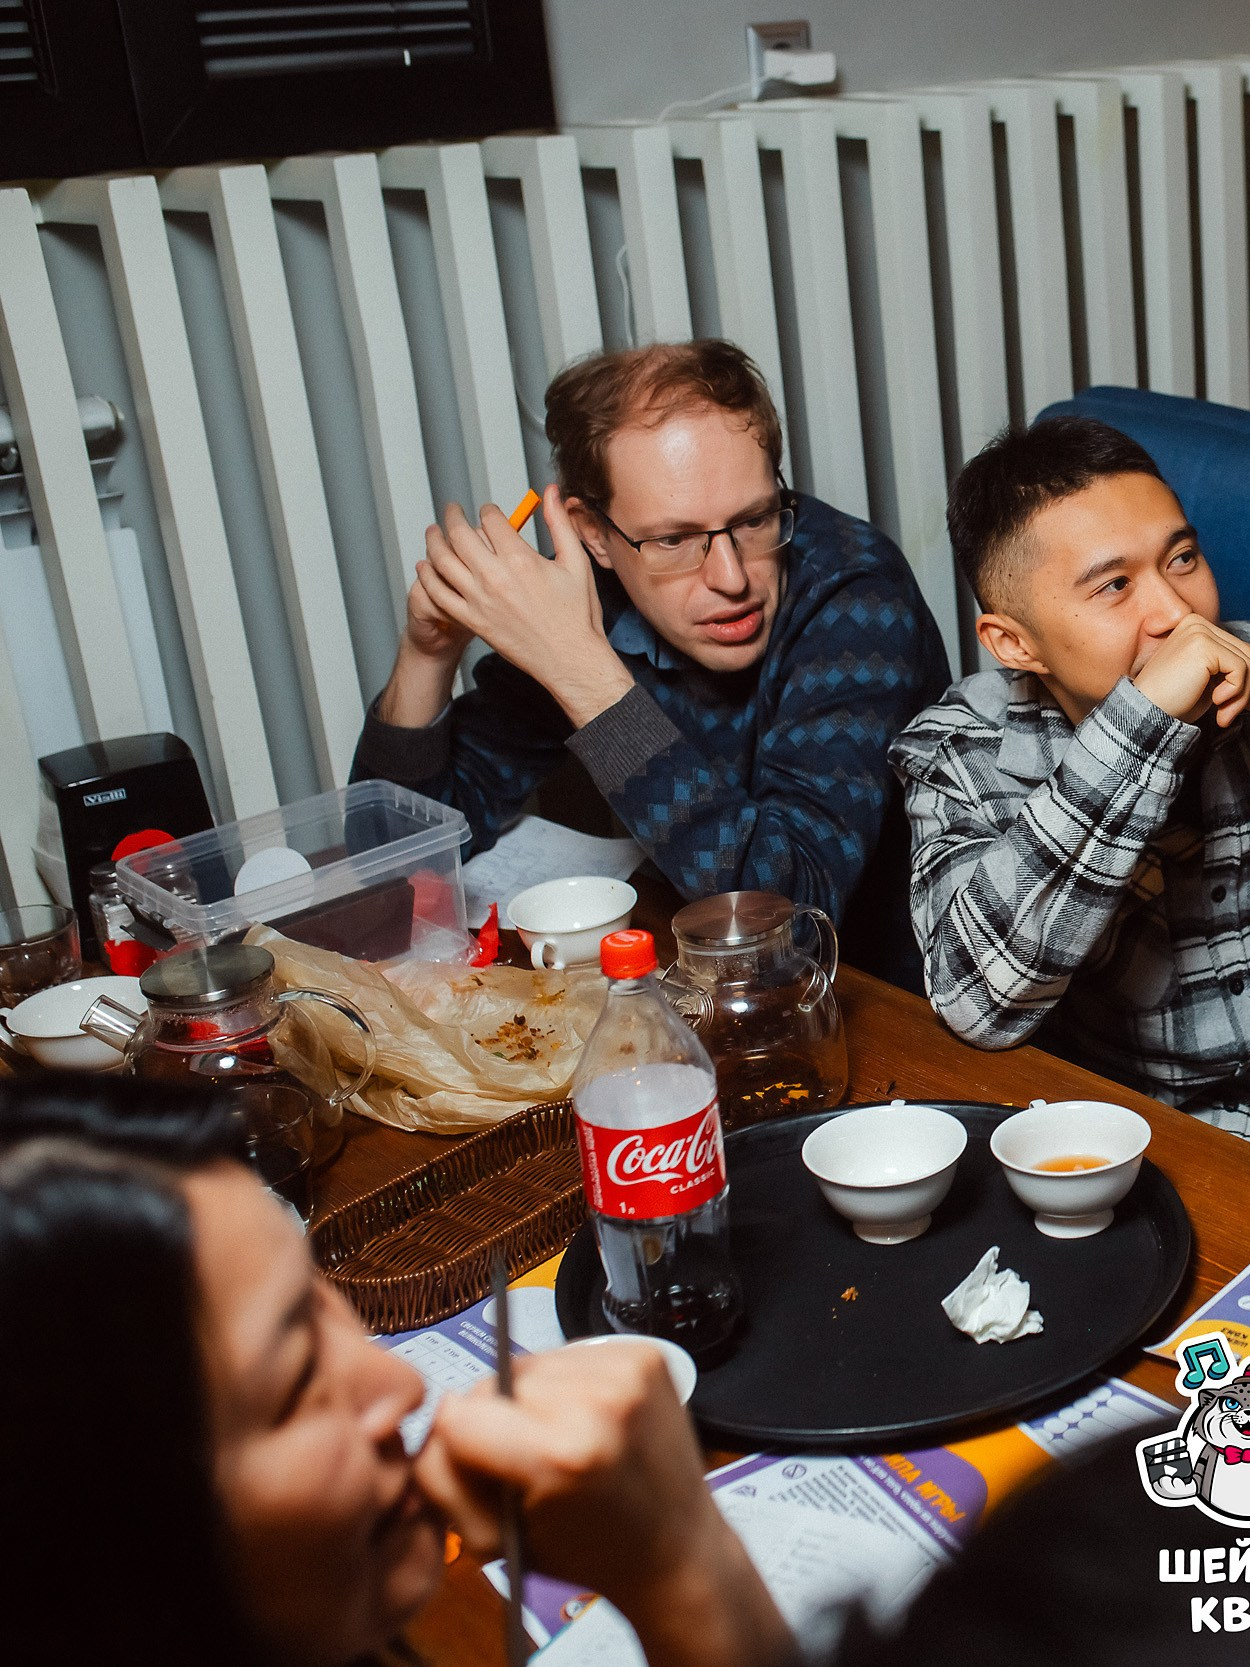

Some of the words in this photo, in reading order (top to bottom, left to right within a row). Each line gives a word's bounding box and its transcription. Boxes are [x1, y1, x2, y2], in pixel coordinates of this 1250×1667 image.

[607, 1103, 724, 1186] Coca-Co
[670, 1167, 715, 1194] CLASSIC
[915, 1480, 966, 1523] ИГРЫ
